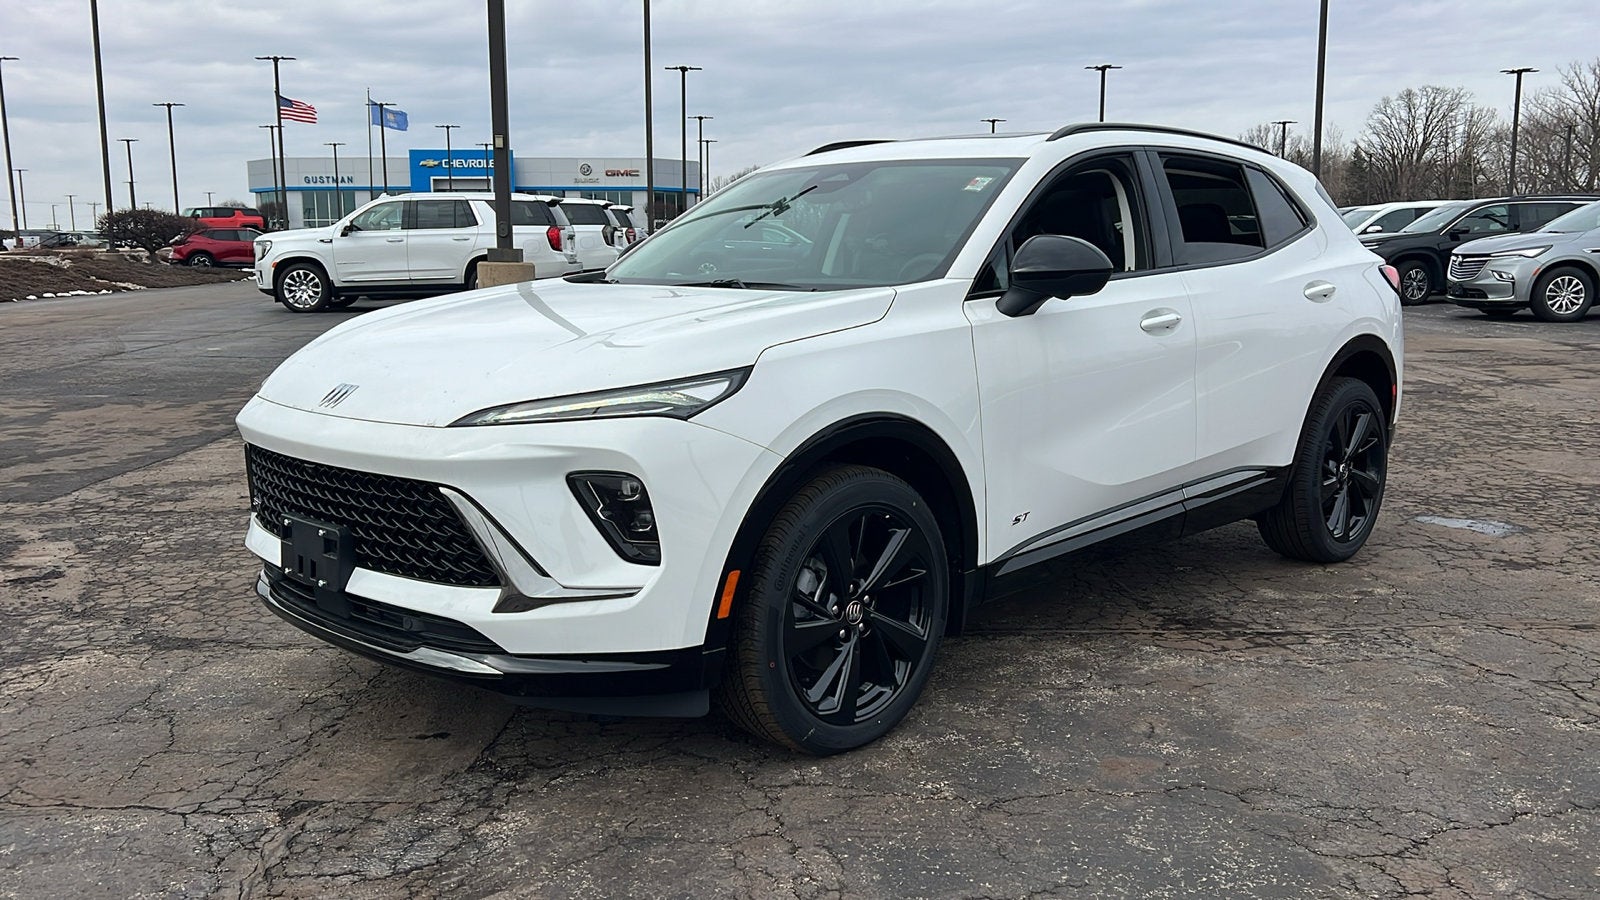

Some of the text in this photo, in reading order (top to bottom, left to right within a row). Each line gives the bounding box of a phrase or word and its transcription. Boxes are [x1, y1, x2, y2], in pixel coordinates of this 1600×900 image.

[442, 159, 494, 168] CHEVROLE
[605, 169, 640, 177] GMC
[304, 176, 353, 184] GUSTMAN
[1012, 511, 1031, 526] ST
[775, 528, 807, 592] Continental
